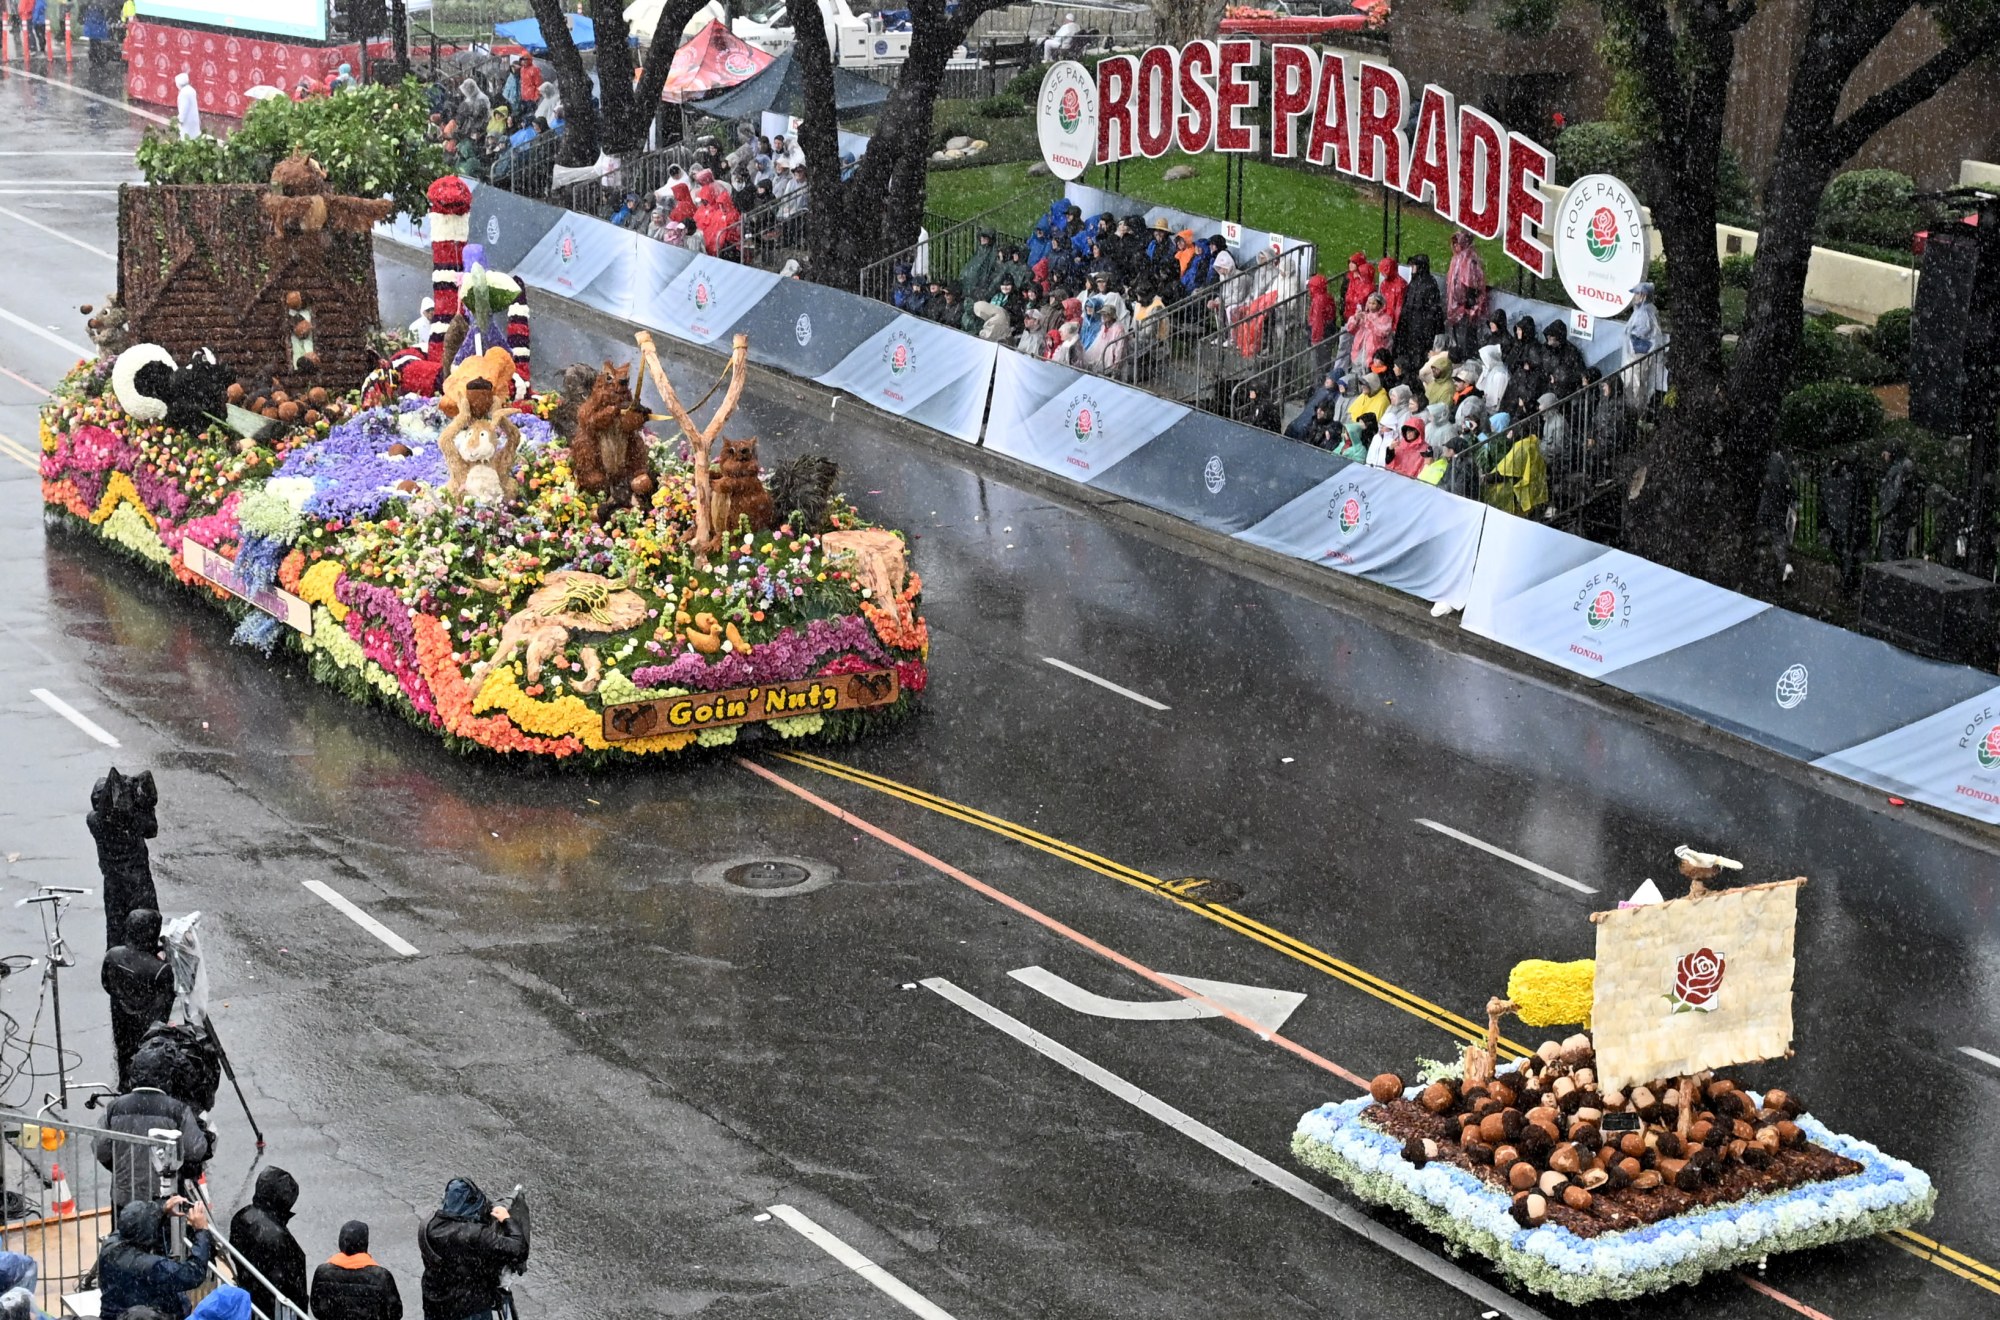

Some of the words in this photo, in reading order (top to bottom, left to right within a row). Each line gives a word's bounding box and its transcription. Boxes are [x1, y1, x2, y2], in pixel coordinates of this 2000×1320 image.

[1045, 70, 1063, 116] ROSE
[1066, 67, 1095, 126] PARADE
[1052, 153, 1083, 169] HONDA
[1096, 38, 1260, 165] ROSE
[1272, 43, 1556, 279] PARADE
[1227, 225, 1236, 238] 15
[1567, 187, 1591, 240] ROSE
[1597, 182, 1641, 254] PARADE
[1577, 285, 1623, 305] HONDA
[1577, 314, 1588, 329] 15
[1065, 395, 1080, 429] ROSE
[1066, 455, 1090, 470] HONDA
[1327, 484, 1345, 520] ROSE
[1573, 574, 1601, 611] ROSE
[1605, 572, 1631, 629] PARADE
[1569, 644, 1604, 663] HONDA
[669, 688, 760, 725] Goin'
[1959, 707, 1993, 749] ROSE
[1955, 784, 2000, 805] HONDA
